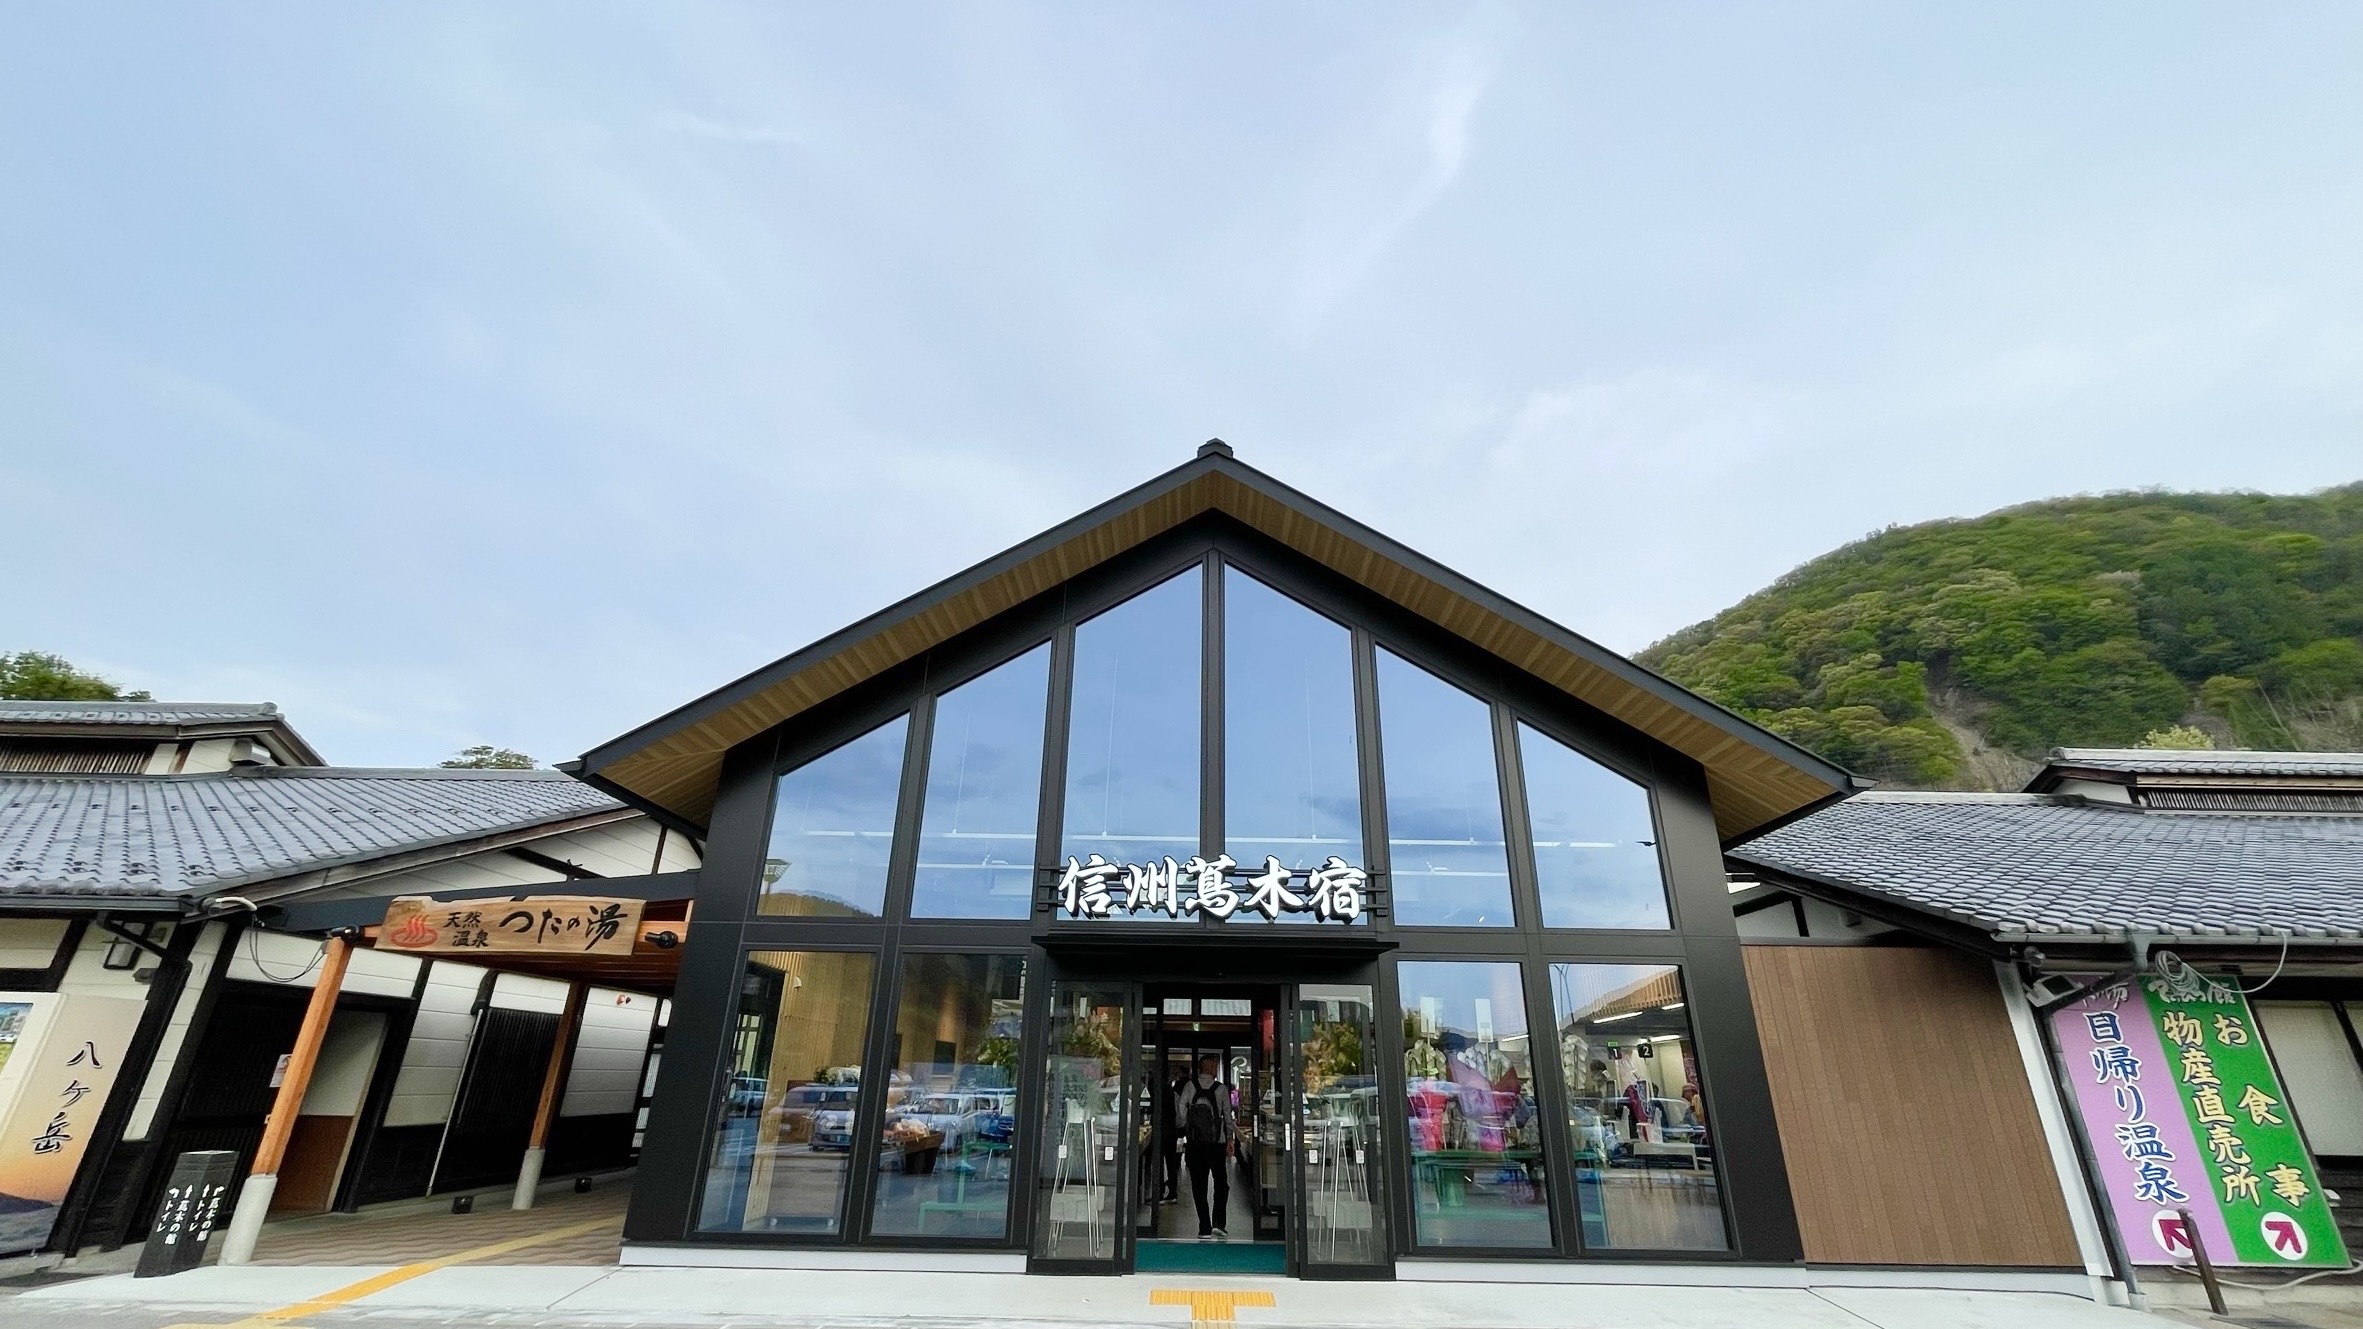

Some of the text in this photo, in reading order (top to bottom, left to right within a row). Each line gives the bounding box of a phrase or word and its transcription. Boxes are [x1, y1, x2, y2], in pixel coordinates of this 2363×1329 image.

[1058, 853, 1367, 920] 信州蔦木宿
[443, 911, 483, 929] 天然
[452, 929, 490, 948] 温泉
[498, 903, 629, 951] つたの湯
[1642, 1046, 1651, 1056] 2
[2083, 1011, 2190, 1205] 日帰り温泉
[2163, 1010, 2261, 1207] 物産直売所
[2213, 1013, 2311, 1207] お食事
[156, 1200, 173, 1232] トイレ
[188, 1199, 206, 1232] トイレ
